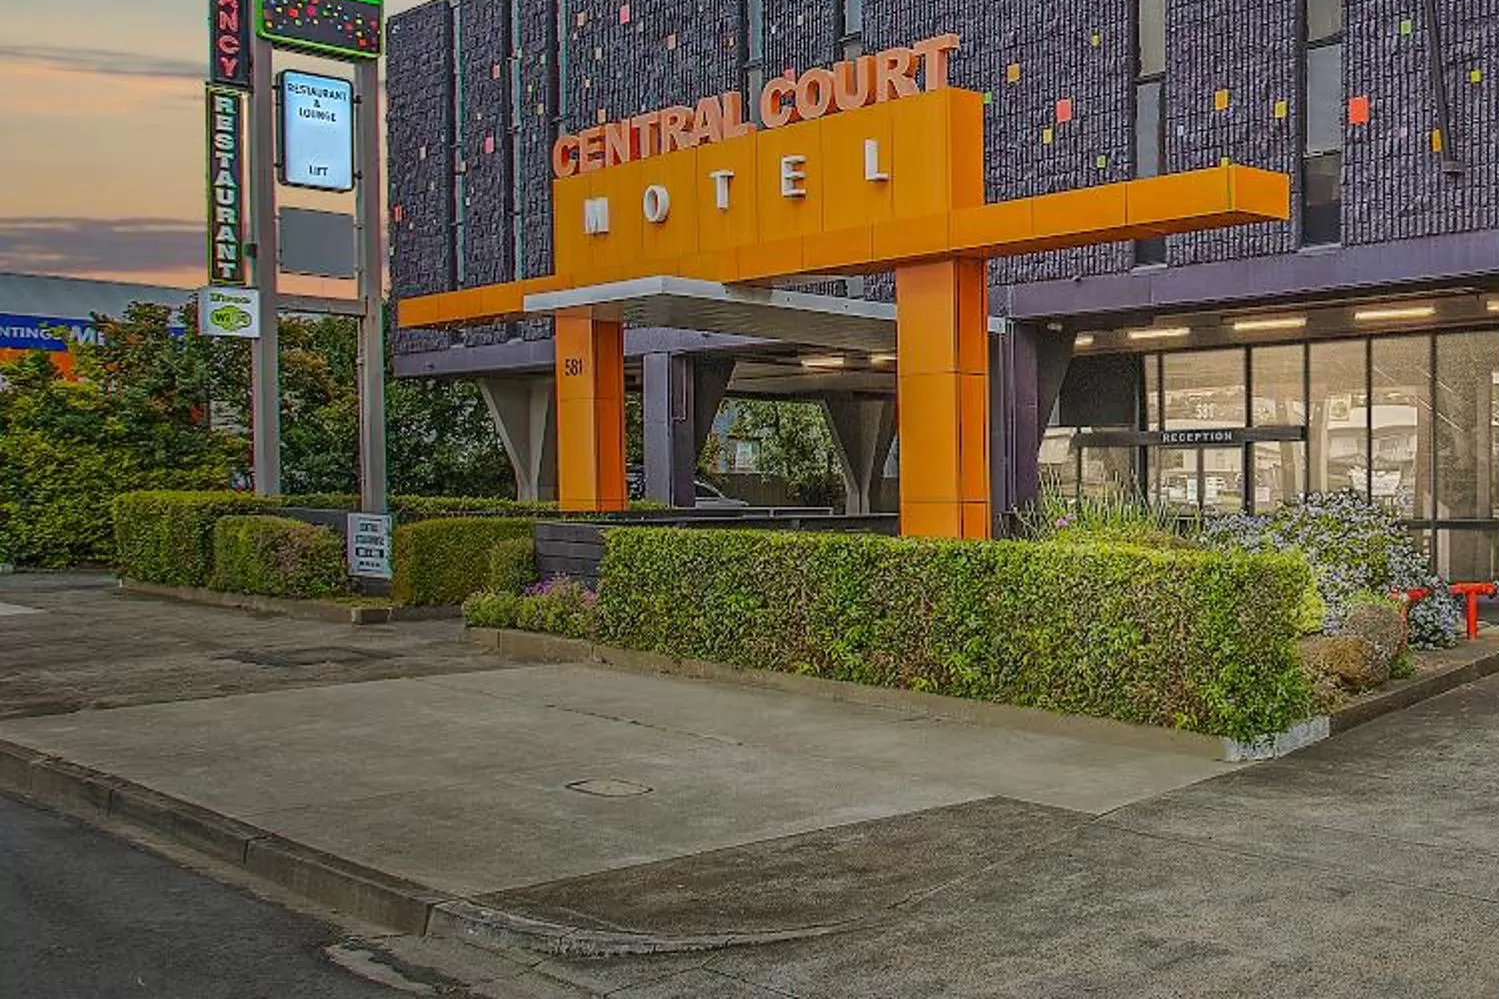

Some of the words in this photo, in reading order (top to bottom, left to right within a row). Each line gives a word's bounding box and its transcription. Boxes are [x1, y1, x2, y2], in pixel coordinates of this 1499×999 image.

[552, 91, 756, 179] CENTRAL
[760, 33, 961, 130] COURT
[213, 94, 238, 280] RESTAURANT
[583, 138, 890, 236] MOTEL
[0, 325, 63, 341] NTING
[564, 358, 583, 376] 581
[1162, 431, 1233, 443] RECEPTION
